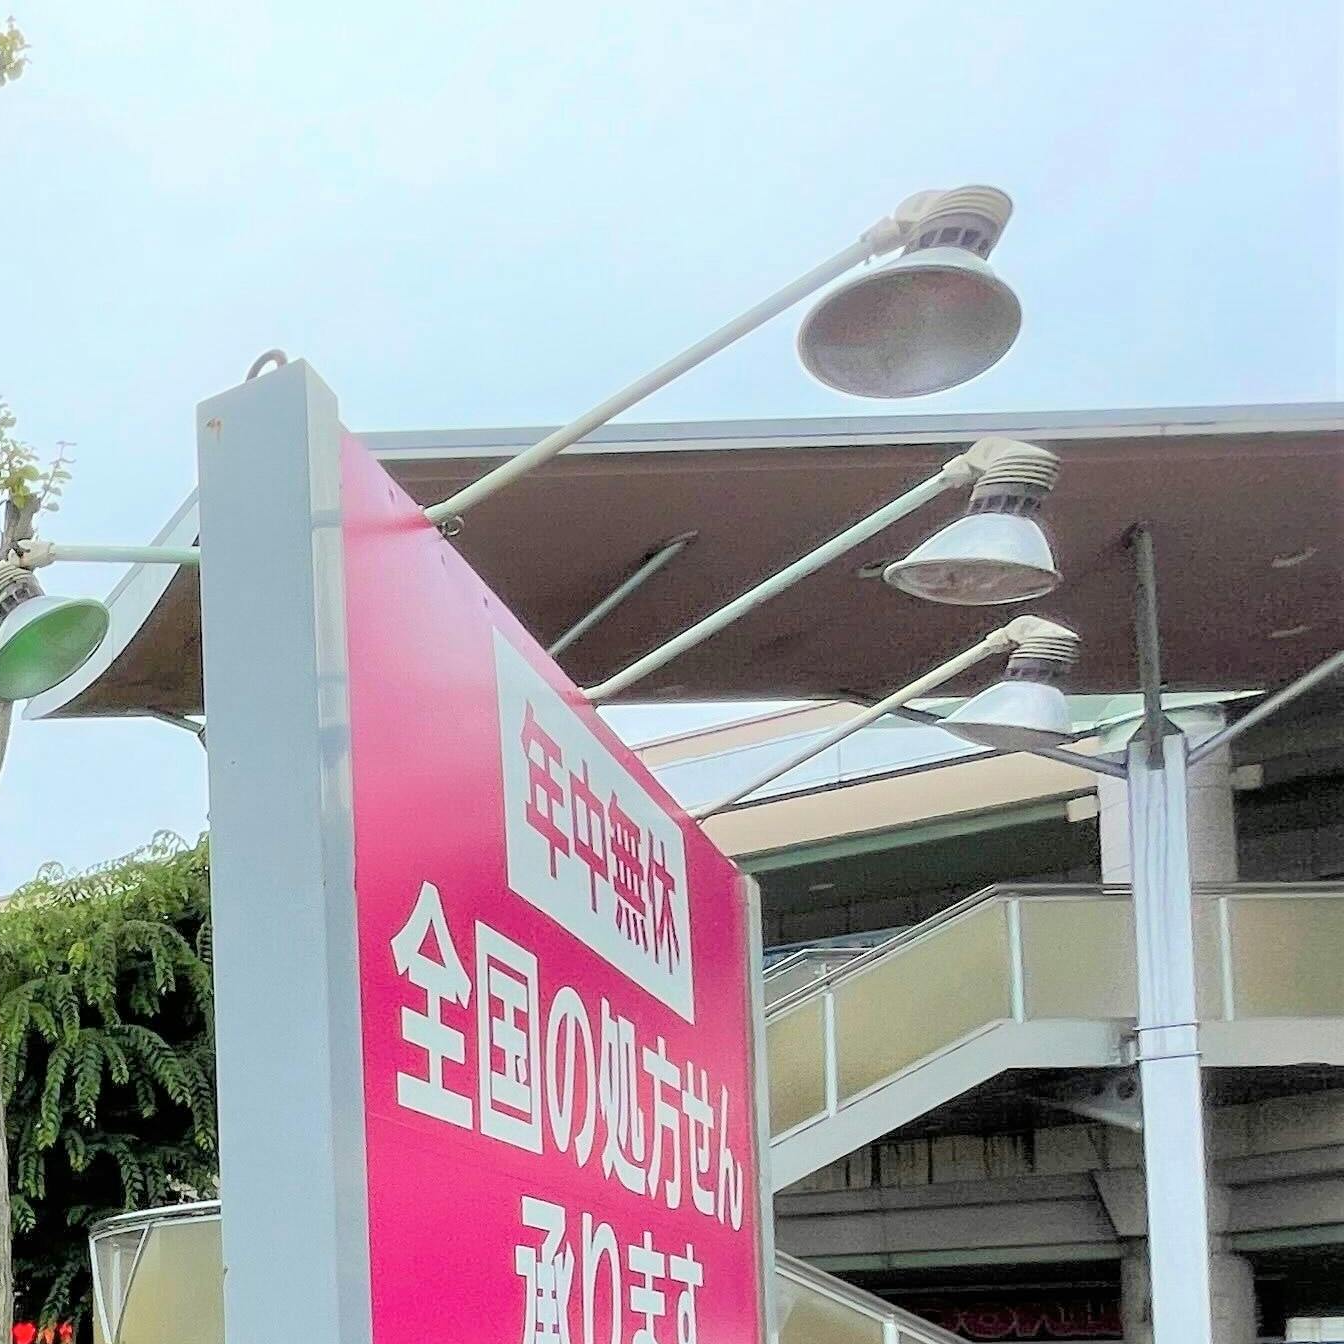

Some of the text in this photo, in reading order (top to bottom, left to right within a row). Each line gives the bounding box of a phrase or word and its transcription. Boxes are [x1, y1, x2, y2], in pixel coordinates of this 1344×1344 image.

[523, 698, 683, 977] 年中無休
[392, 881, 744, 1231] 全国の処方せん
